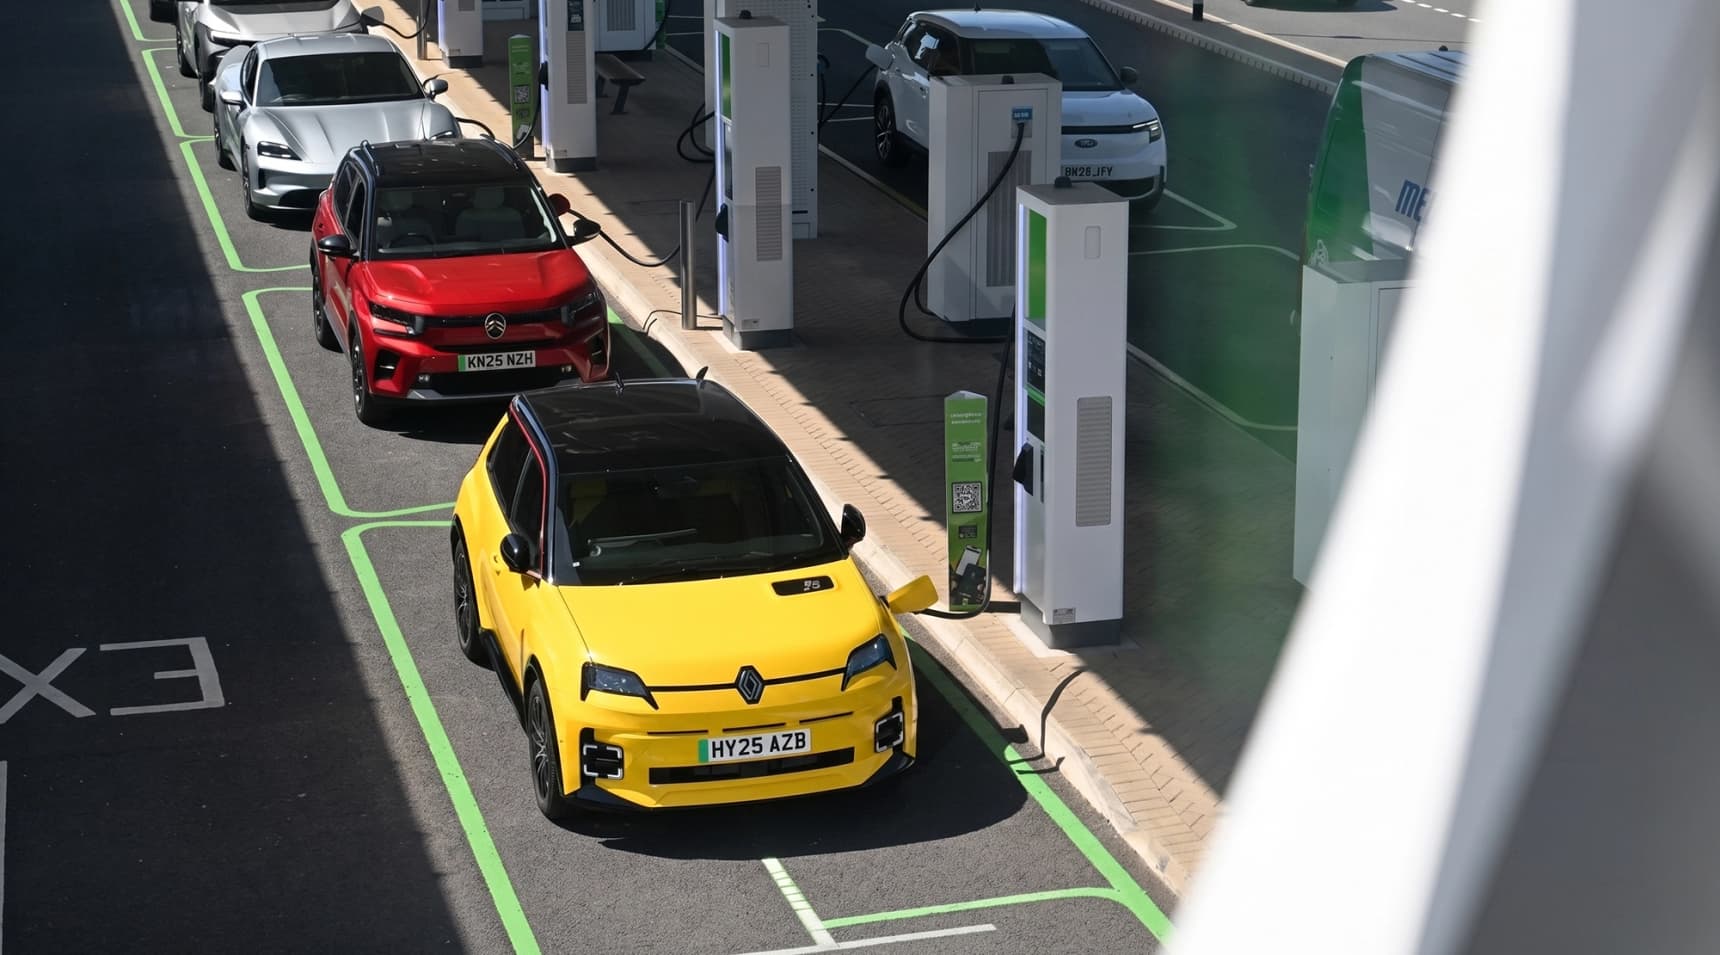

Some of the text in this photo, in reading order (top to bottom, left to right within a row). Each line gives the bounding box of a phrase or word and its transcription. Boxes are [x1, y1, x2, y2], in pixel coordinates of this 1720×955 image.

[467, 352, 533, 368] KN25 NZH
[711, 732, 806, 758] HY25 AZB
